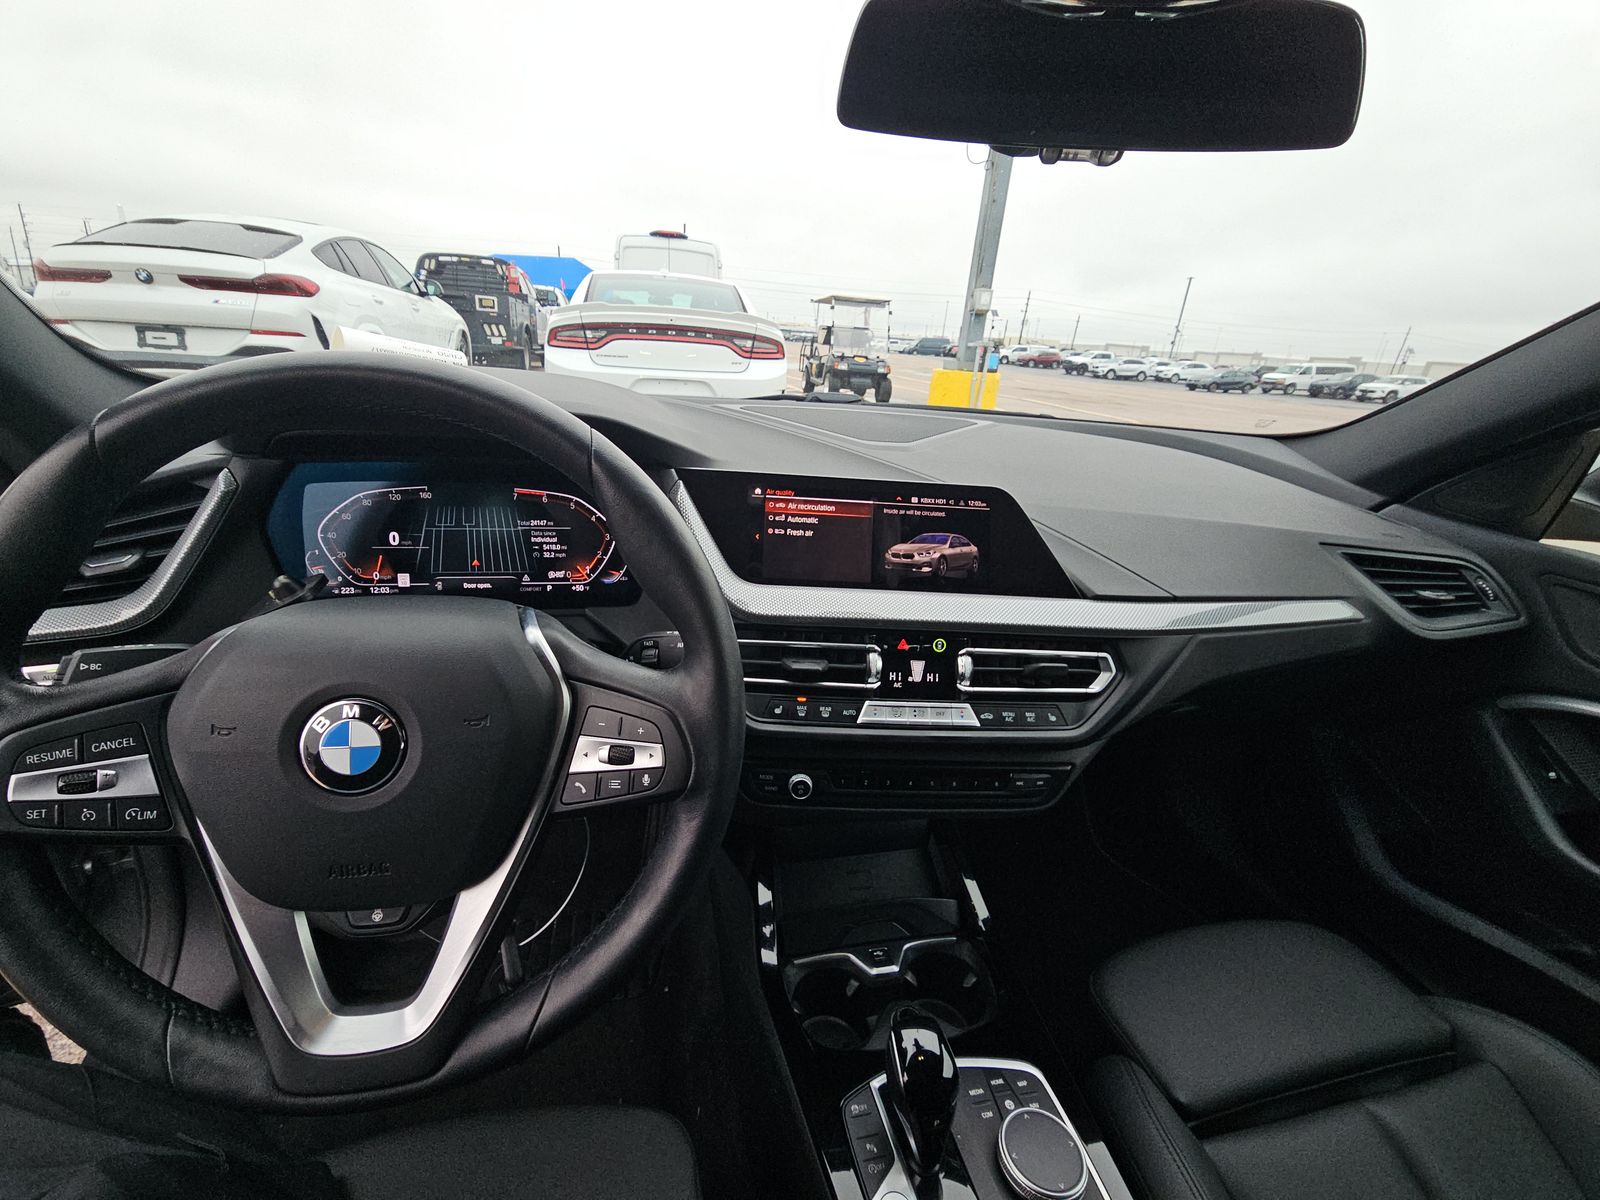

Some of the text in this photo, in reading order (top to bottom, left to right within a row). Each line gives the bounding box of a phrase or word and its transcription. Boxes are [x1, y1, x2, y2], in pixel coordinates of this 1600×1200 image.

[570, 502, 576, 510] 5
[798, 503, 836, 512] recirculation
[787, 515, 818, 524] Automatic
[388, 531, 400, 546] 0
[372, 572, 379, 580] 0
[889, 672, 901, 681] HI
[927, 673, 939, 682] HI
[312, 704, 392, 734] BMW
[91, 737, 136, 753] CANCEL
[26, 748, 74, 764] RESUME
[26, 809, 47, 820] SET
[137, 810, 157, 820] LIM
[328, 863, 393, 880] AIRBAG
[990, 1078, 1004, 1086] HOME
[968, 1088, 984, 1096] MEDIA
[981, 1110, 993, 1119] COM
